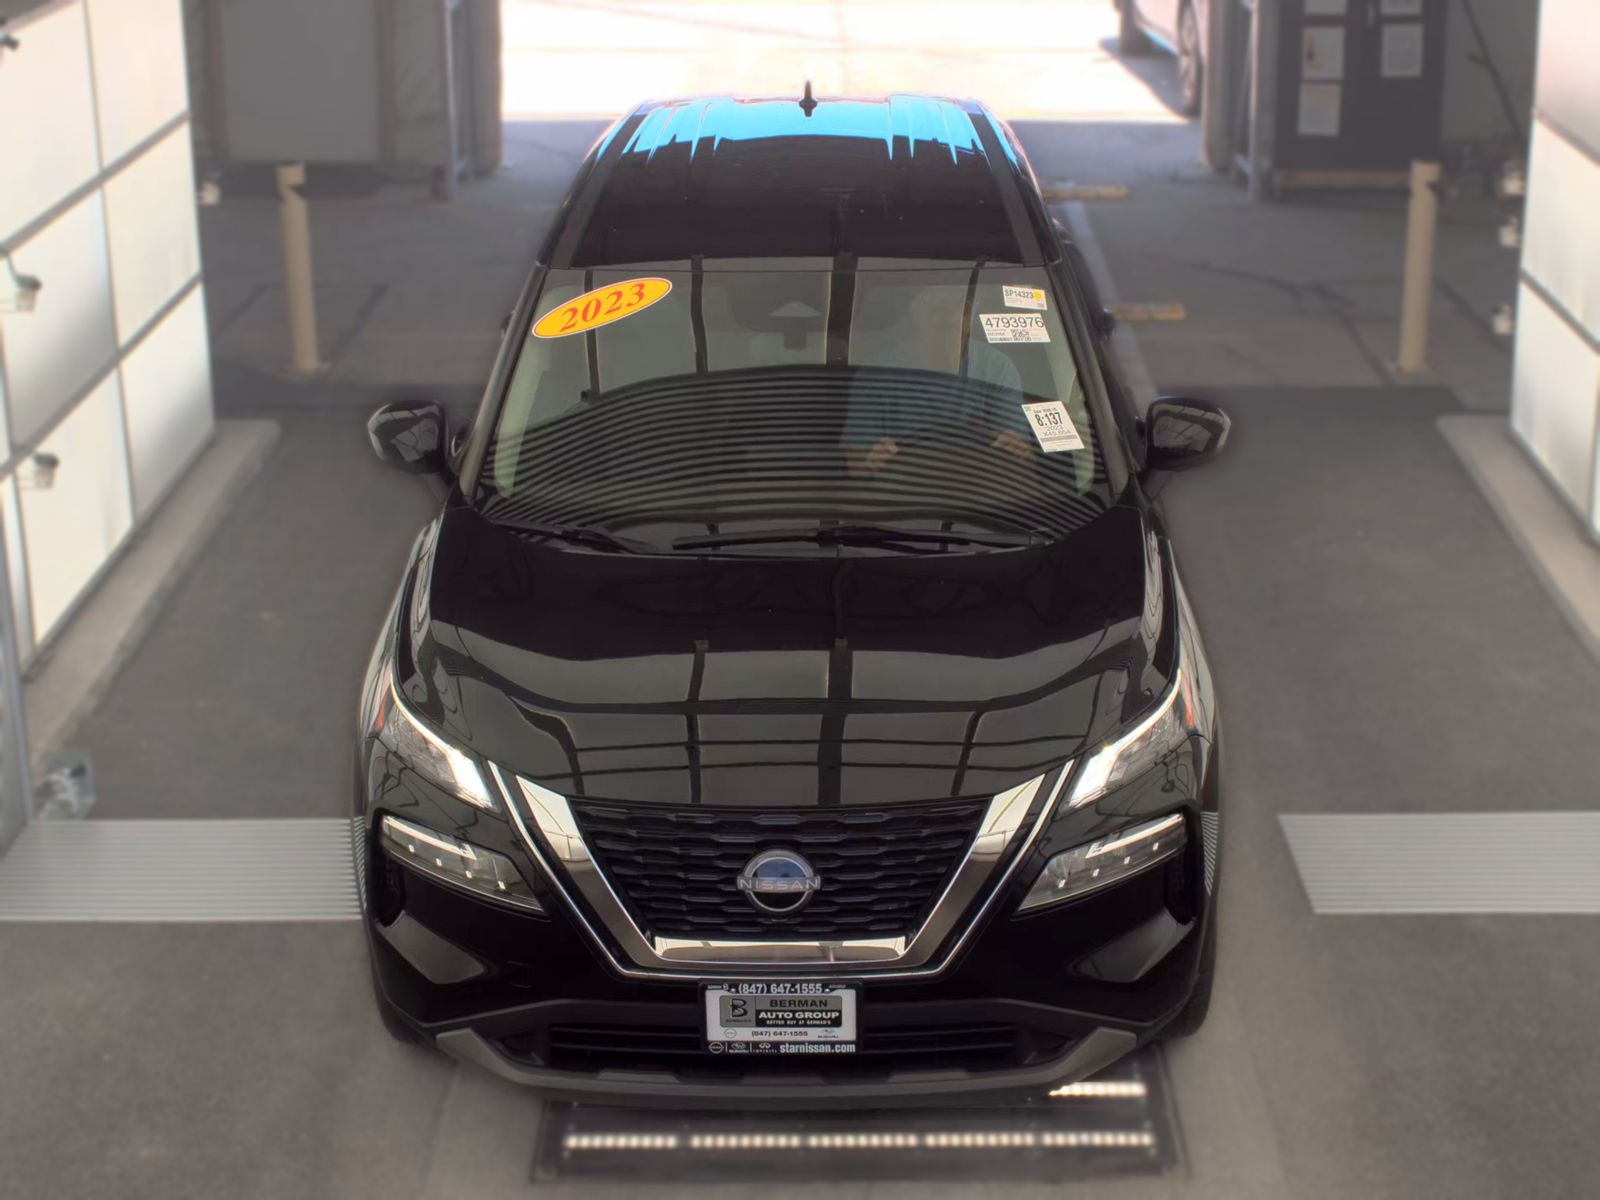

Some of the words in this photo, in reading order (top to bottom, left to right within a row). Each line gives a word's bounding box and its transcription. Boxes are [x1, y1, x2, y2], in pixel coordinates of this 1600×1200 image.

[559, 282, 645, 332] 2023
[985, 316, 1045, 328] 4793976
[1035, 411, 1063, 427] 8:137
[740, 879, 818, 890] NISSAN
[738, 983, 768, 995] (847)
[770, 983, 823, 994] 647-1555
[769, 999, 828, 1008] BERMAN
[758, 1011, 793, 1019] AUTO
[795, 1011, 840, 1019] GROUP
[779, 1042, 856, 1053] starnissan.com
